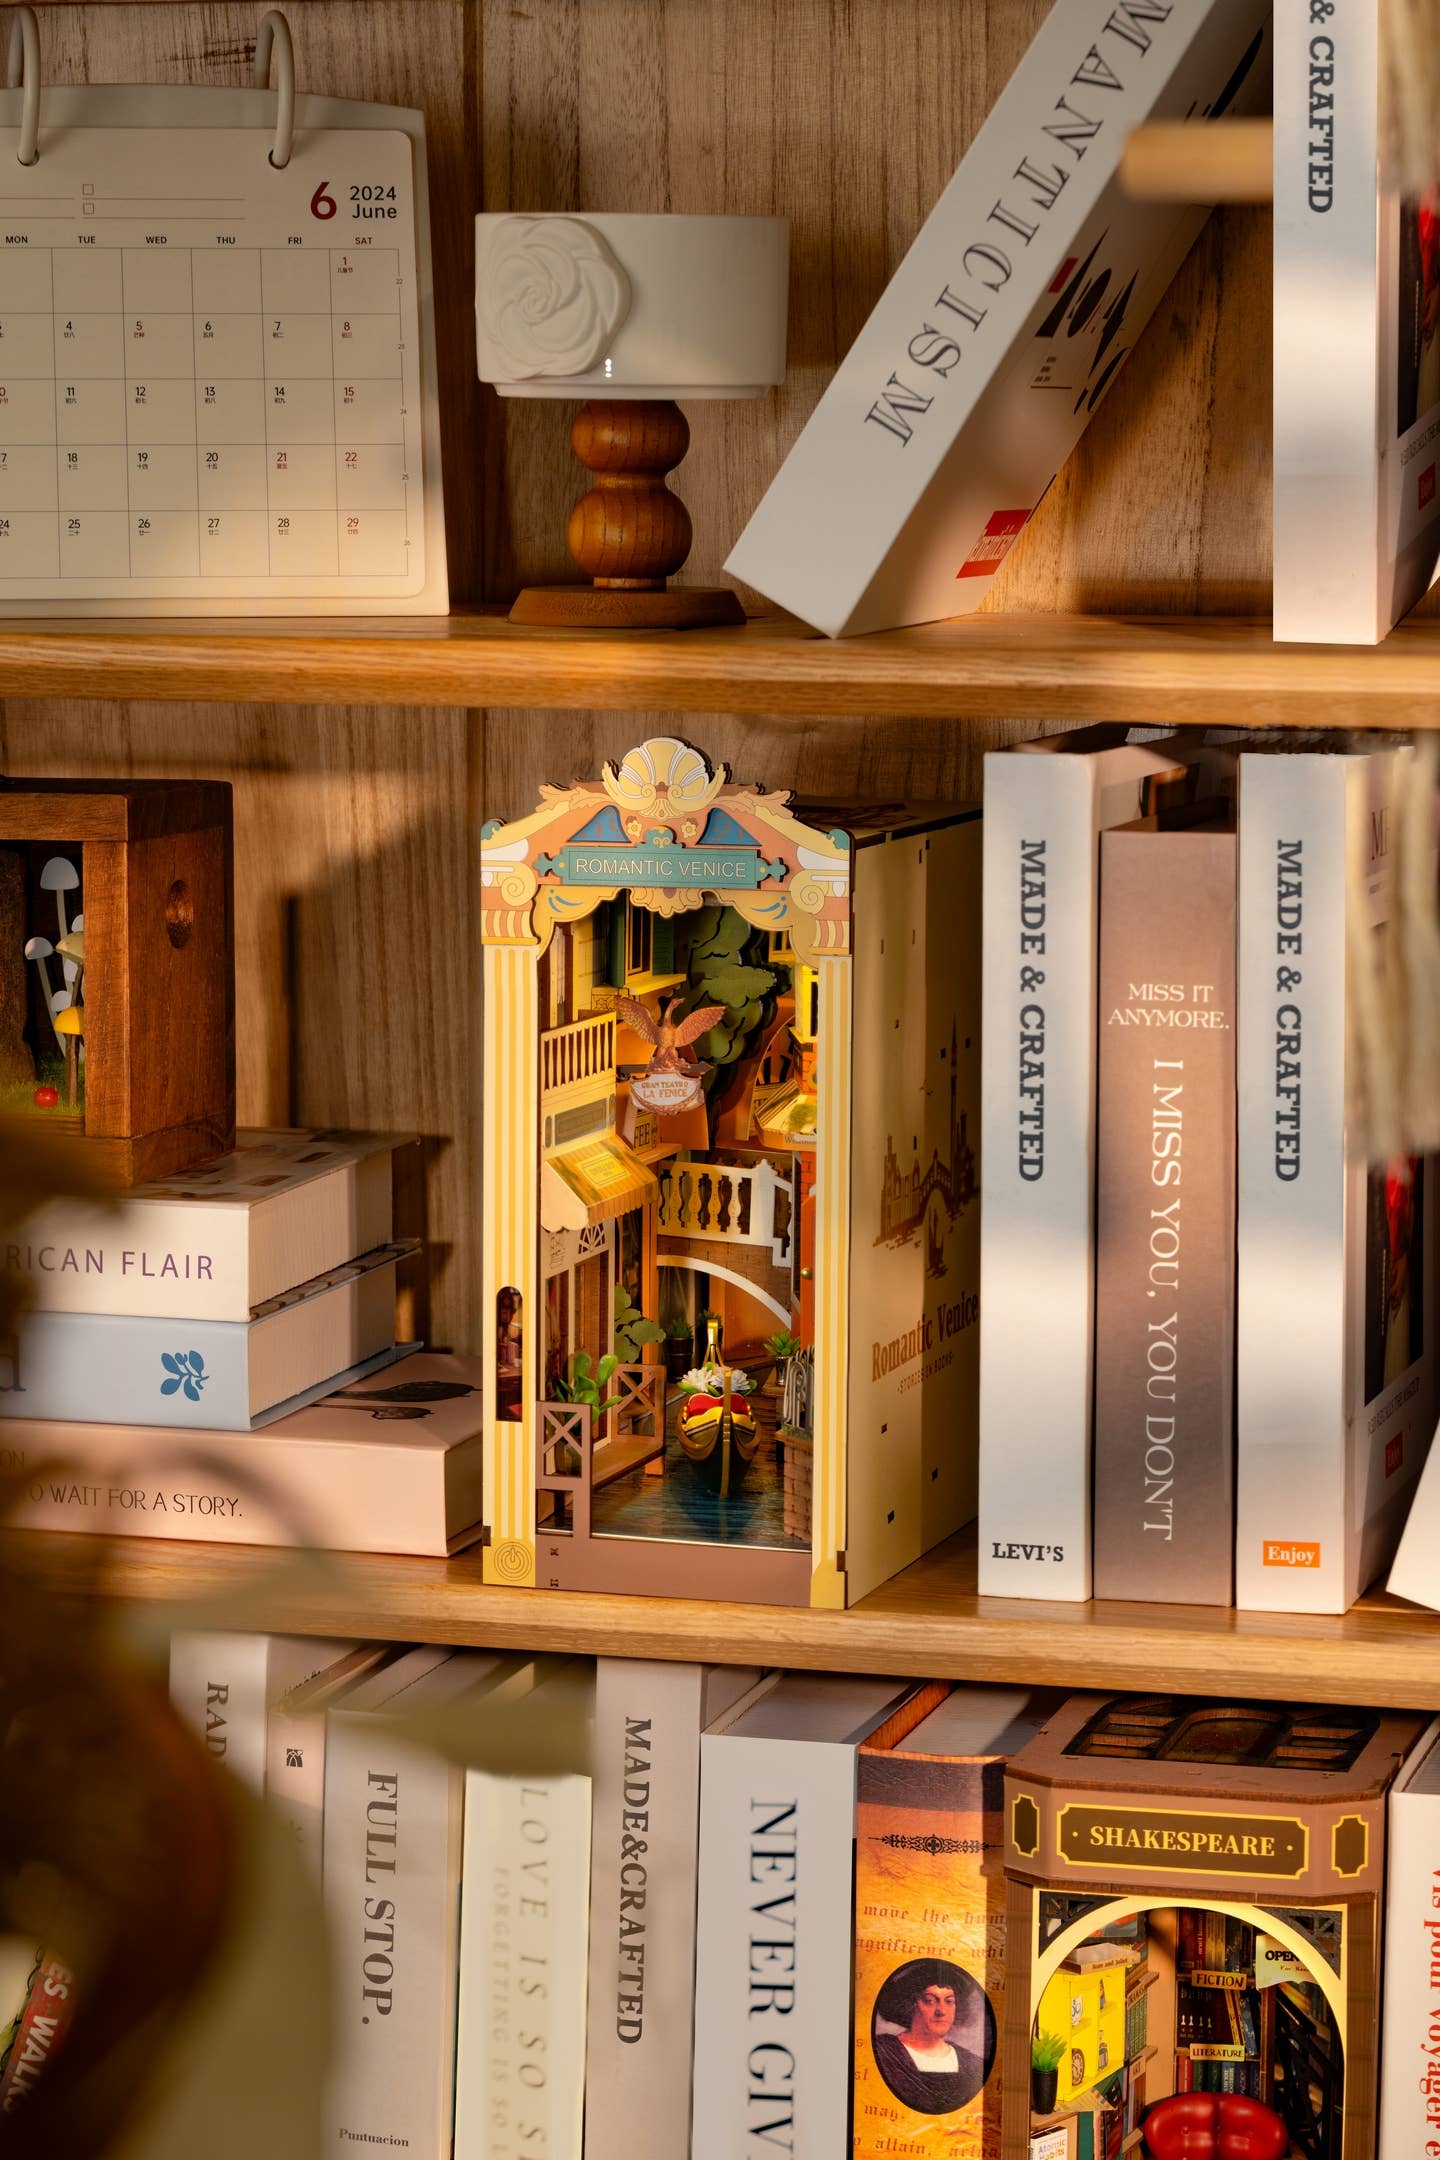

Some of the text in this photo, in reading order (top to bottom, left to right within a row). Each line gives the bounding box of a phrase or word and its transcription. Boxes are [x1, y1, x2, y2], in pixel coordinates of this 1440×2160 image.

[1307, 36, 1335, 213] CRAFTED
[310, 181, 337, 220] 6
[349, 185, 397, 201] 2024
[351, 203, 398, 219] June
[5, 235, 373, 245] MON TUE WED THU FRI SAT
[342, 256, 348, 266] 1
[65, 321, 350, 331] 4 5 6 7 8
[66, 386, 75, 397] 11
[135, 386, 146, 397] 12
[204, 386, 216, 397] 13
[274, 386, 285, 397] 14
[343, 386, 355, 397] 15
[67, 452, 78, 463] 18
[137, 452, 149, 463] 19
[205, 452, 219, 463] 20
[276, 452, 288, 463] 21
[344, 451, 358, 462] 22
[67, 518, 81, 529] 25
[137, 518, 151, 529] 26
[207, 518, 220, 528] 27
[277, 518, 290, 528] 28
[346, 517, 359, 527] 29
[574, 857, 748, 879] ROMANTIC VENICE
[1128, 983, 1214, 1003] MISS IT
[1018, 840, 1047, 1182] MADE & CRAFTED
[1107, 1008, 1230, 1030] ANYMORE.
[1275, 840, 1303, 1182] MADE & CRAFTED
[643, 1088, 688, 1098] LA FENICE
[121, 1251, 213, 1280] FLAIR
[1142, 1059, 1184, 1541] I MISS YOU, YOU DON'T
[871, 1290, 979, 1383] Romantic Venice
[49, 1484, 102, 1507] WAIT
[108, 1489, 146, 1511] FOR
[152, 1492, 168, 1513] A
[172, 1494, 243, 1518] STORY.
[991, 1542, 1064, 1563] LEVI'S
[1267, 1544, 1316, 1564] Enjoy
[1089, 1825, 1277, 1857] SHAKESPEARE
[616, 1715, 652, 2045] MADE&CRAFTED
[361, 1768, 399, 2026] FULL STOP.
[746, 1797, 798, 2021] NEVER
[863, 1904, 909, 1920] move
[923, 1908, 949, 1924] the
[516, 1785, 550, 2160] LOVE IS SO S
[1194, 1973, 1245, 1988] FICTION
[1191, 2048, 1244, 2058] LITERATURE
[337, 2126, 410, 2149] Puntuacion
